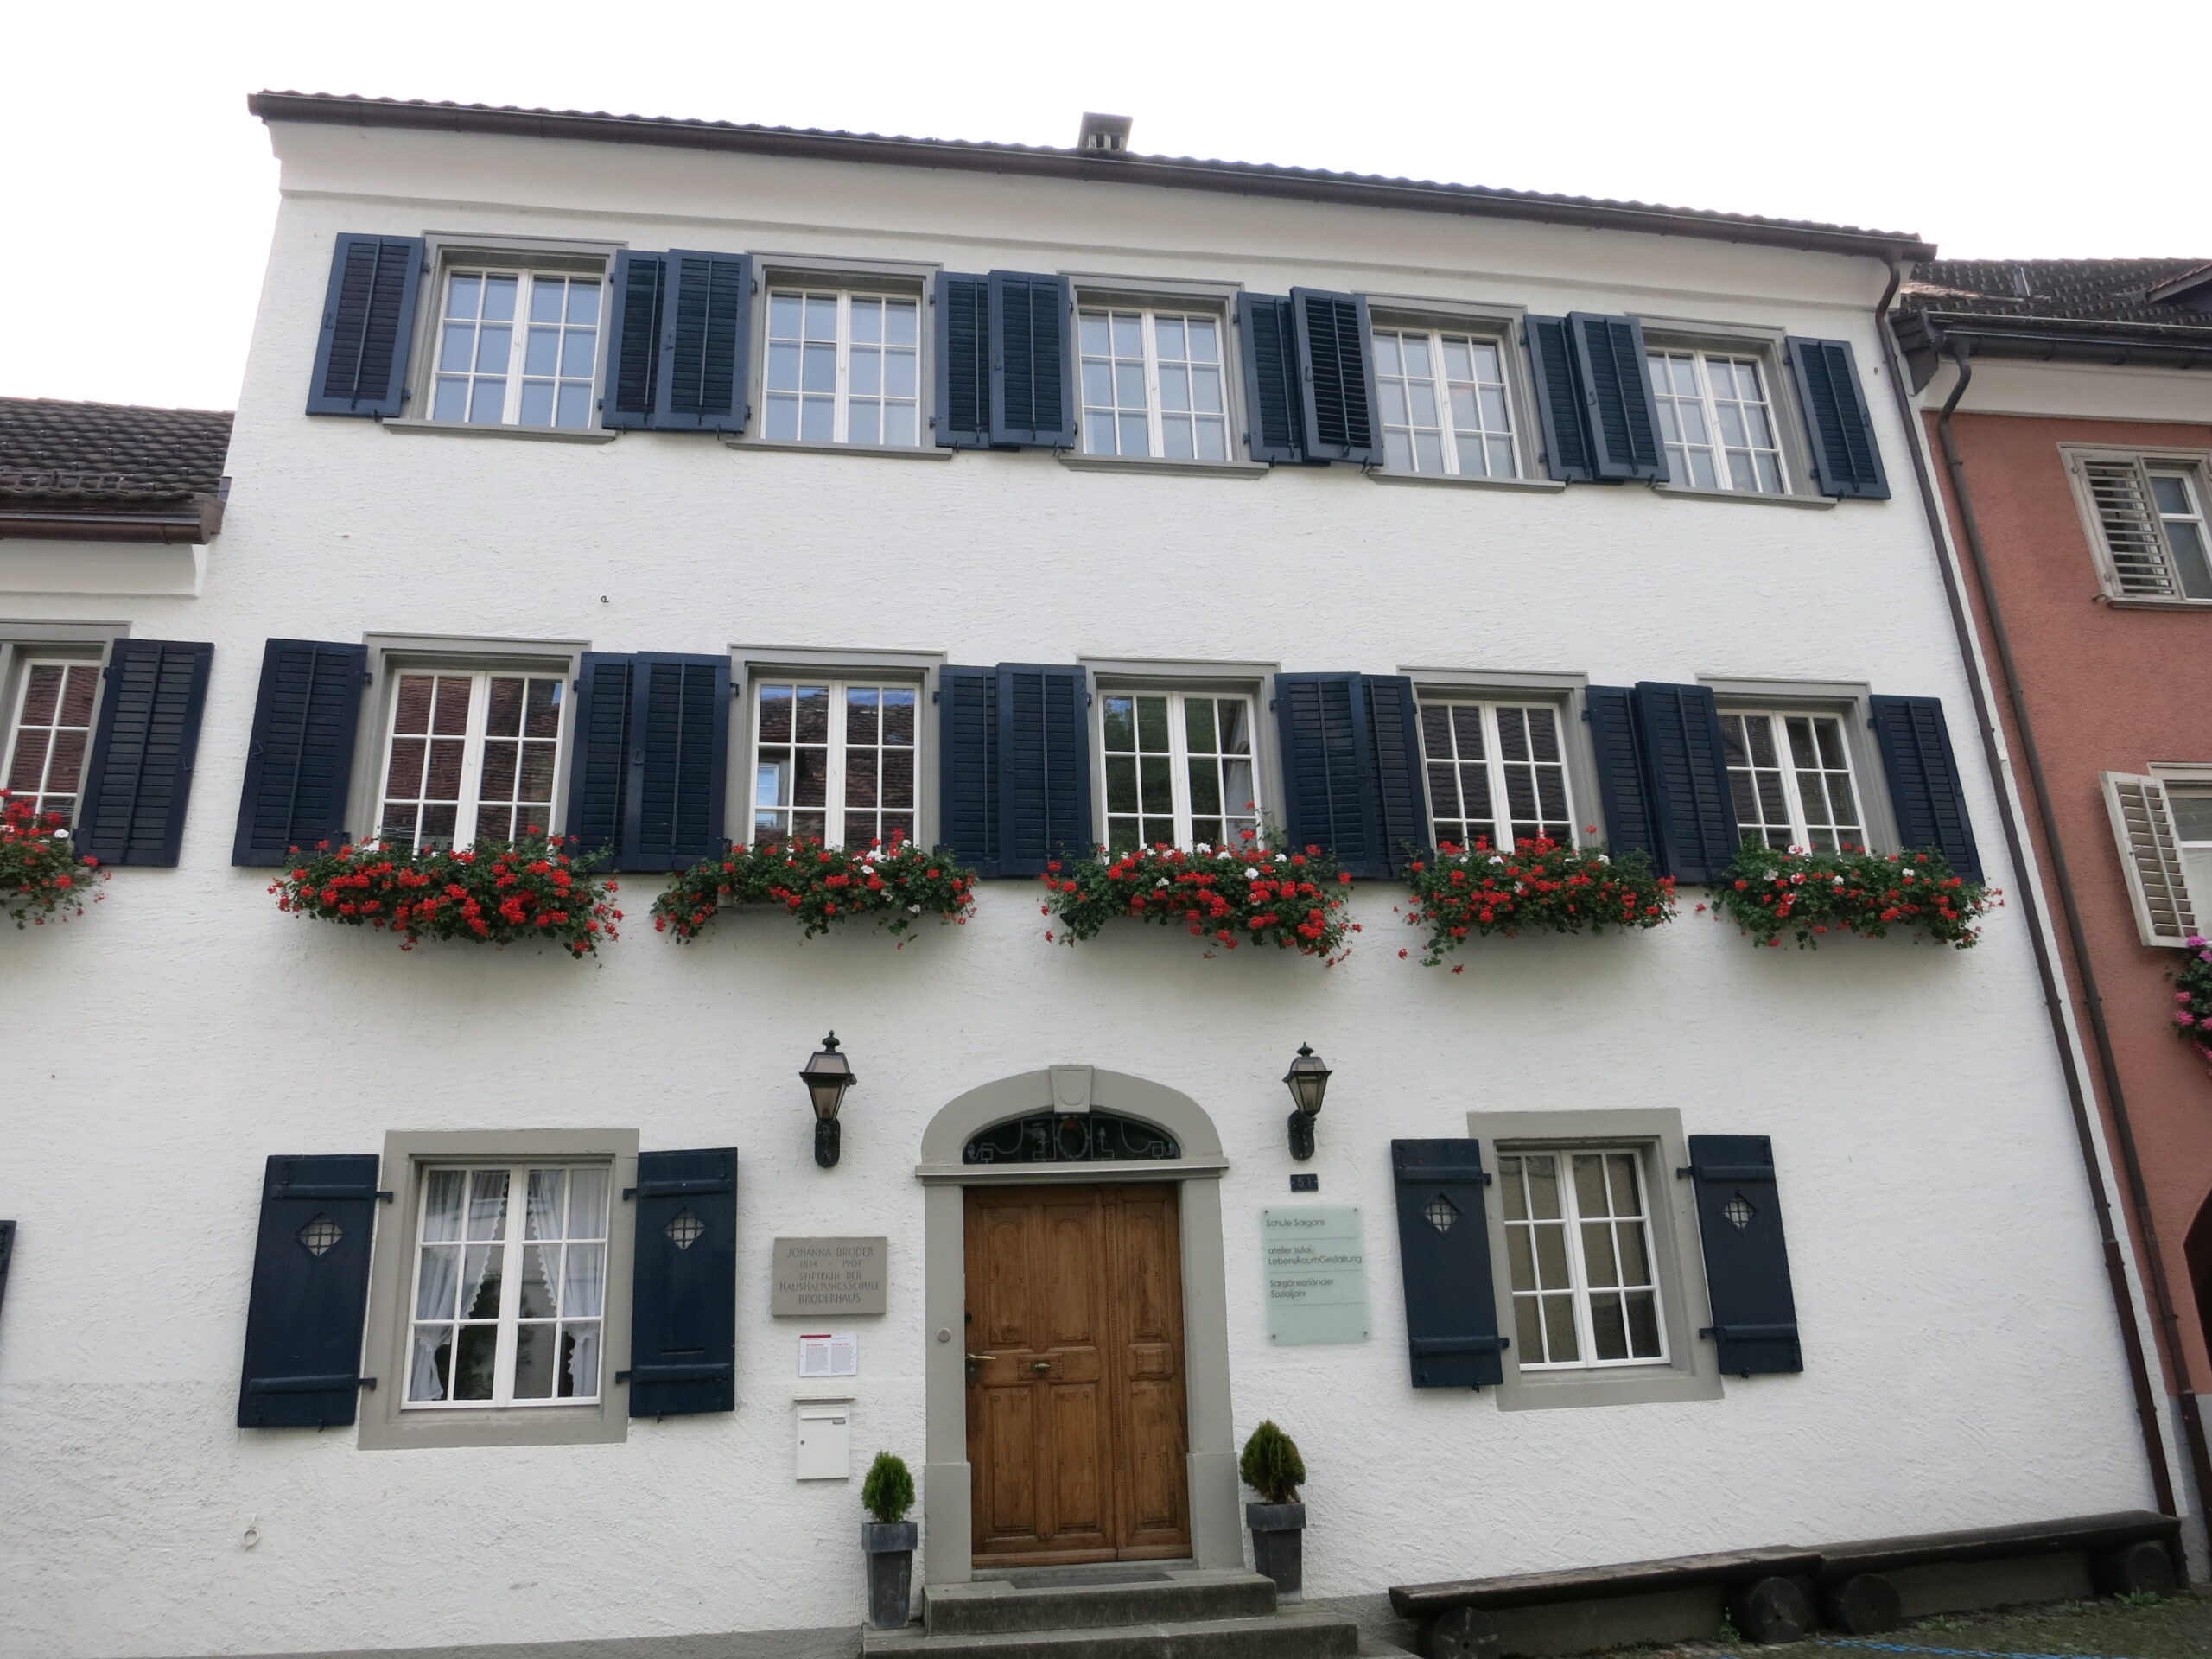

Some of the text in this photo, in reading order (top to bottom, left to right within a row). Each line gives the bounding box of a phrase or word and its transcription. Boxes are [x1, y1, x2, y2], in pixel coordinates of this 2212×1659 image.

[1297, 1176, 1312, 1188] 51
[1266, 1218, 1325, 1228] Schule Sargans
[786, 1246, 874, 1258] JOHANNA BRODER
[1268, 1255, 1363, 1266] LebensRaumGestaltung
[798, 1271, 862, 1281] STIFTERIN DER
[798, 1293, 861, 1304] BRODERHAUS
[1270, 1289, 1306, 1300] Sozialjahr
